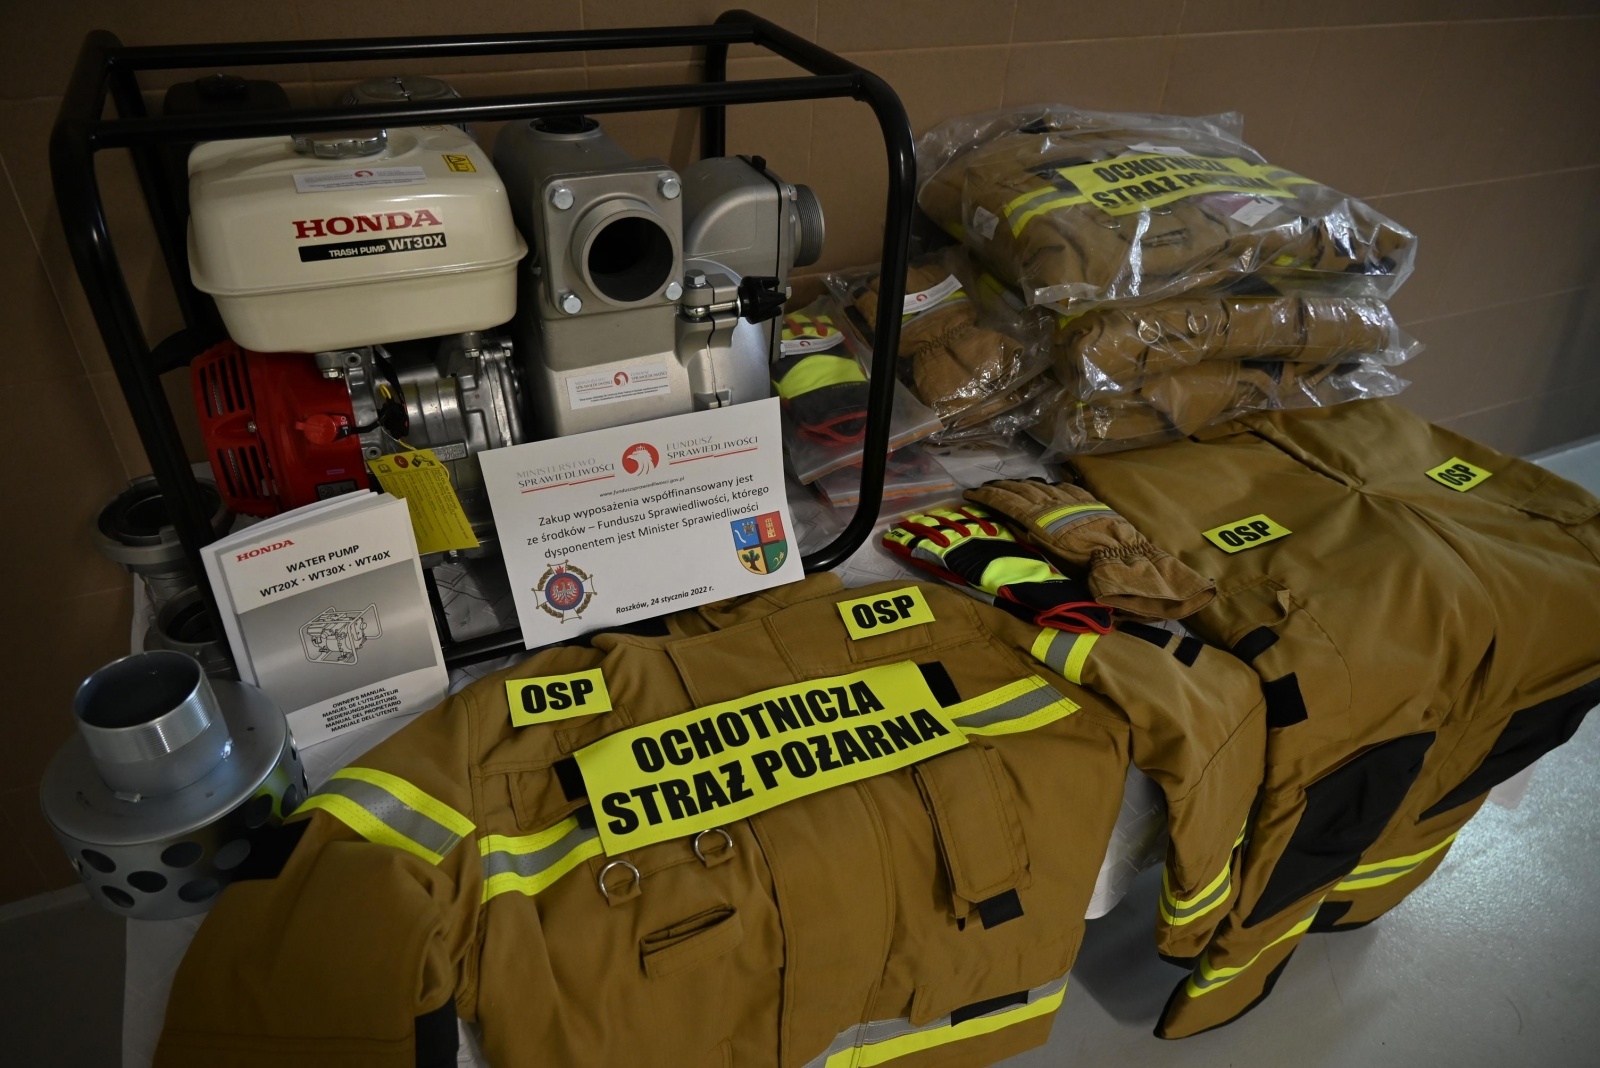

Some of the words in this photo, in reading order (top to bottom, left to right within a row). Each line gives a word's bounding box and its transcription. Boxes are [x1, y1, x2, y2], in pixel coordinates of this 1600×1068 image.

[292, 209, 442, 239] HONDA
[328, 245, 358, 258] TRASH
[360, 244, 386, 255] PUMP
[388, 234, 444, 251] WT30X
[666, 436, 712, 450] FUNDUSZ
[667, 436, 758, 460] SPRAWIEDLIWOŚCI
[516, 458, 596, 478] MINISTERSTWO
[518, 463, 615, 488] SPRAWIEDLIWOŚCI
[1437, 464, 1478, 486] OSP
[538, 513, 571, 526] Zakup
[574, 498, 639, 518] wyposażenia
[642, 479, 734, 504] współfinansowany
[735, 474, 754, 486] jest
[527, 536, 538, 546] ze
[541, 526, 586, 542] środków
[597, 512, 646, 530] Funduszu
[648, 494, 730, 520] Sprawiedliwości,
[732, 486, 769, 501] którego
[544, 536, 615, 558] dysponentem
[618, 531, 636, 544] jest
[638, 520, 680, 538] Minister
[682, 502, 759, 529] Sprawiedliwości
[1218, 520, 1270, 547] OSP
[236, 540, 294, 562] HONDA
[286, 555, 326, 573] WATER
[328, 544, 360, 560] PUMP
[260, 578, 299, 597] WT20X
[308, 564, 346, 582] WT30X
[354, 550, 391, 567] WT40X
[616, 602, 649, 614] Roszków,
[650, 598, 660, 606] 24
[660, 592, 689, 604] stycznia
[690, 586, 708, 596] 2022
[851, 594, 916, 630] OSP
[322, 706, 348, 718] MANUEL
[358, 688, 398, 706] L'UTILISATEUR
[326, 696, 398, 722] BEDIENUNGSANLEITUNG
[332, 696, 360, 708] OWNER'S
[360, 688, 386, 698] MANUAL
[520, 678, 594, 714] OSP
[326, 717, 352, 728] MANUAL
[364, 700, 402, 715] PROPIETARIO
[331, 720, 360, 732] MANUALE
[362, 706, 398, 722] DELL'UTENTE
[631, 680, 885, 773] OCHOTNICZA
